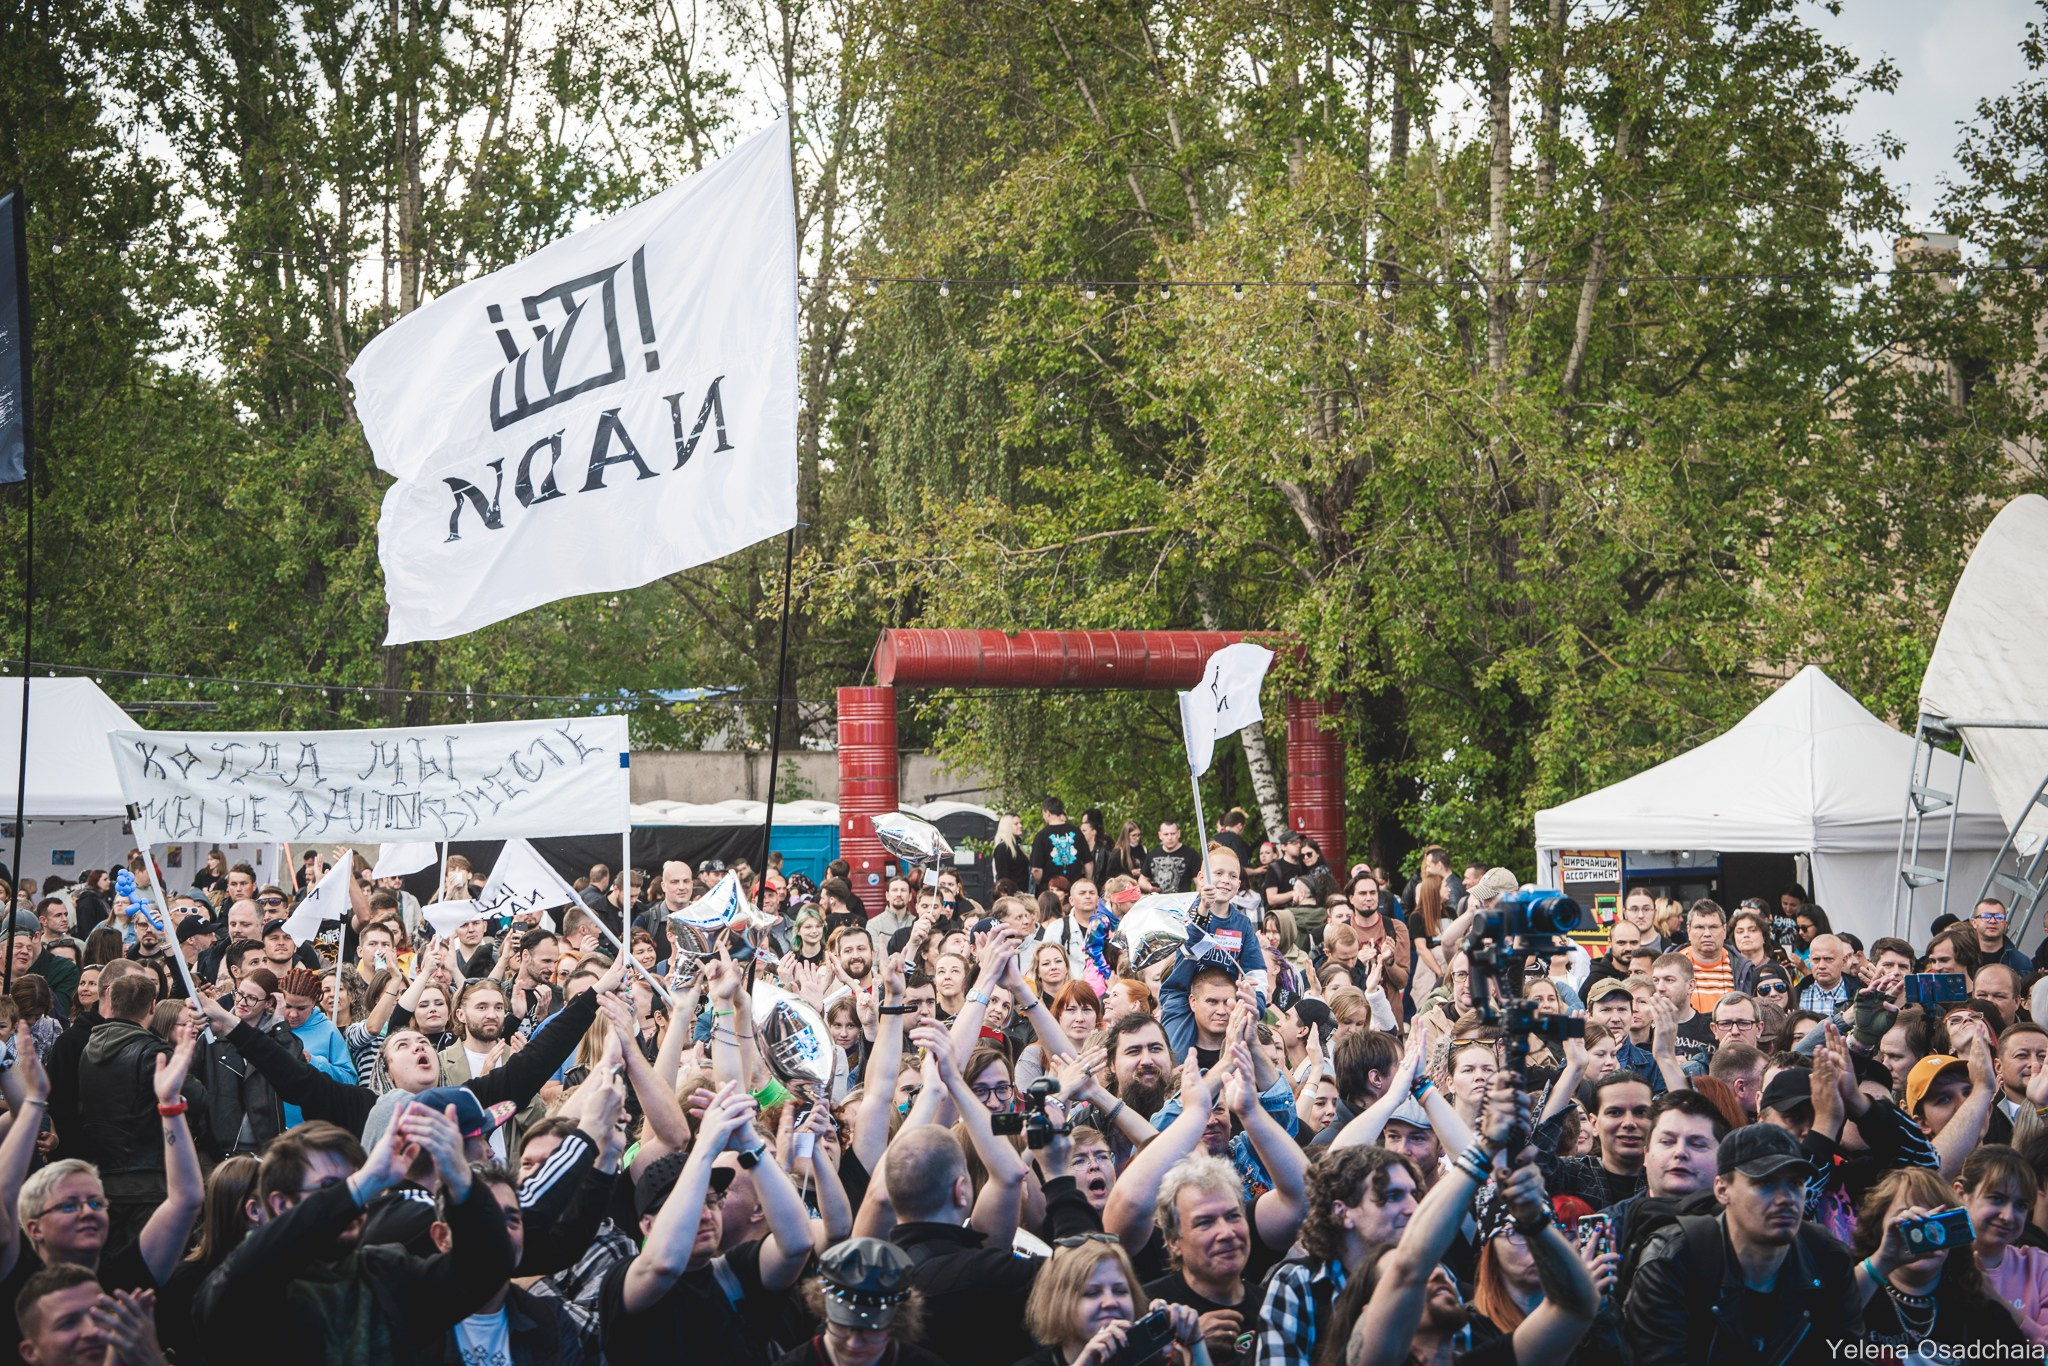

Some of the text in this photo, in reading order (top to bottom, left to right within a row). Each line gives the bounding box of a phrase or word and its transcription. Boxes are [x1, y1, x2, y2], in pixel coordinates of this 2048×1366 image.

[135, 740, 327, 788] КОГДА
[358, 734, 462, 789] МЫ
[141, 795, 204, 840] МЫ
[217, 794, 271, 840] НЕ
[1563, 856, 1618, 868] ШИРОЧАЙШИЙ
[1565, 870, 1618, 881] АССОРТИМЕНТ
